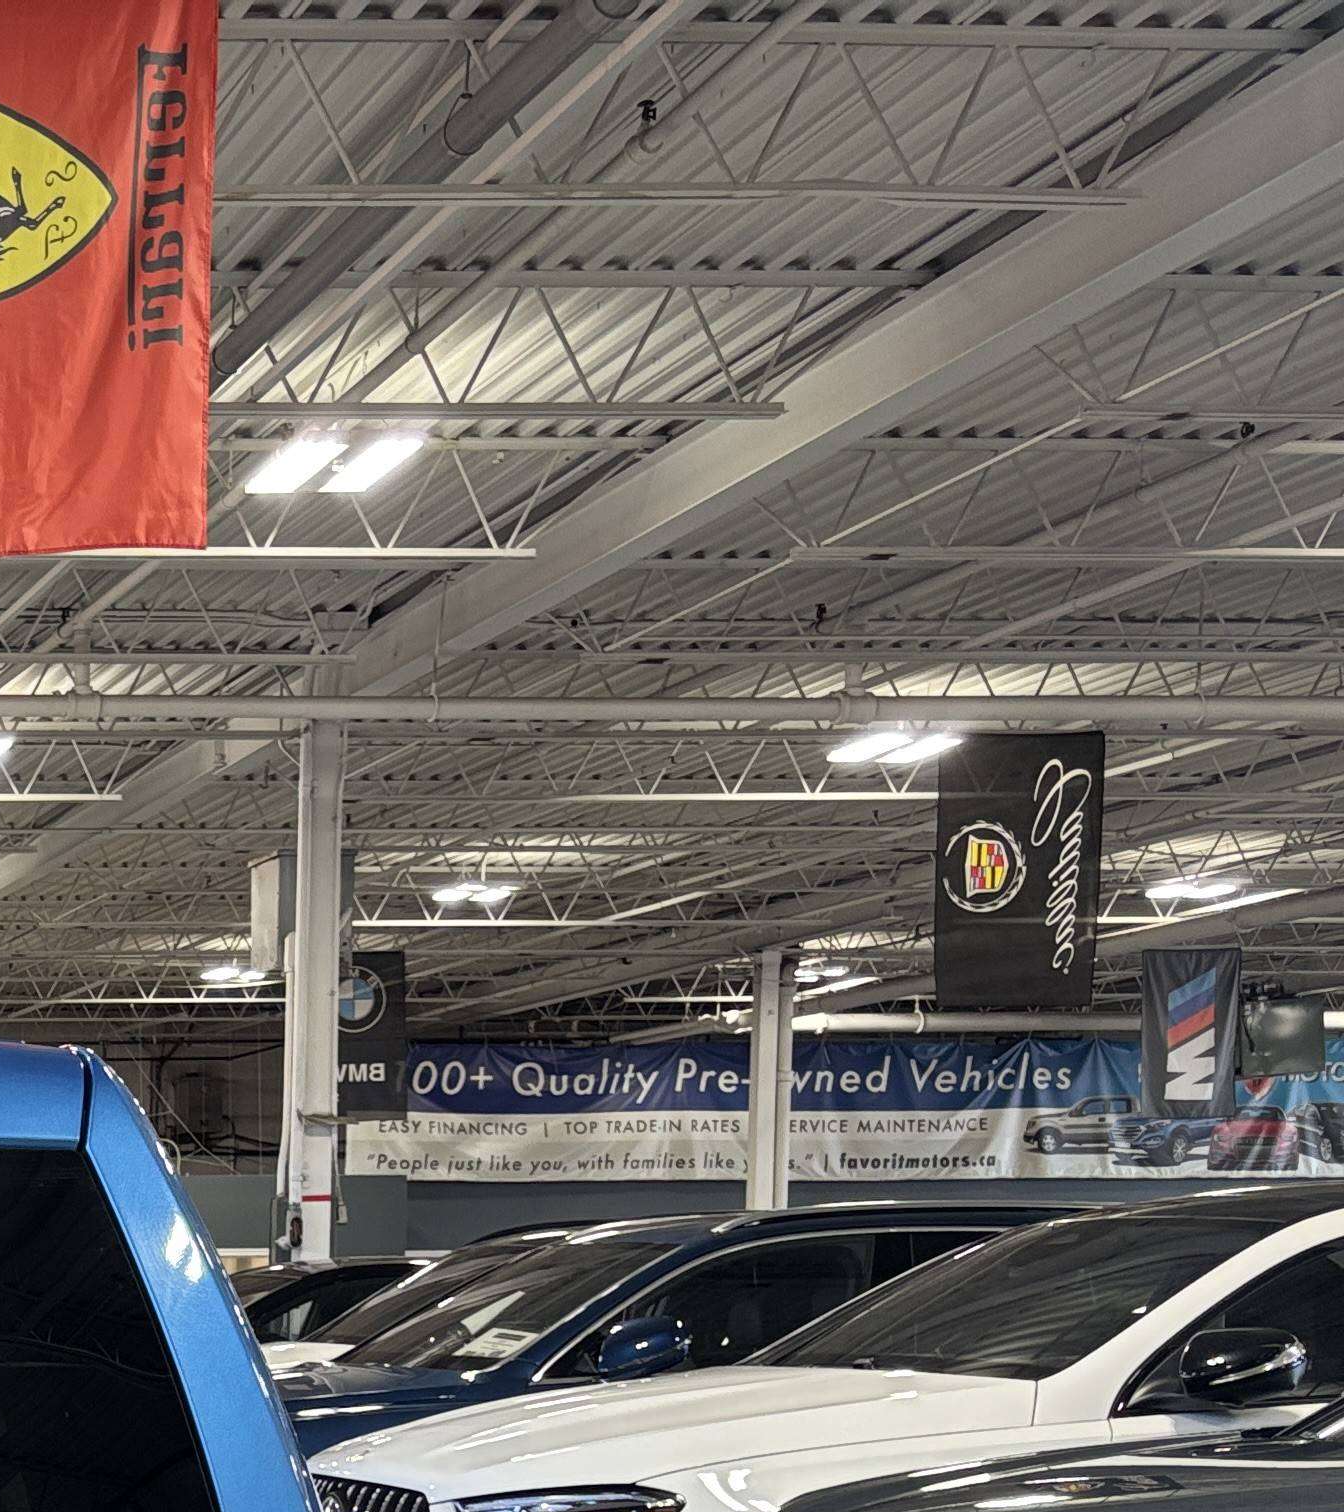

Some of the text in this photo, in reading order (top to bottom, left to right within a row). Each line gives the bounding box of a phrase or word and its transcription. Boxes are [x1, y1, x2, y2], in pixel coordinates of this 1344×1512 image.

[512, 1057, 661, 1104] Quality
[673, 1056, 891, 1094] Pre-wned
[910, 1052, 1073, 1093] Vehicles
[378, 1117, 989, 1137] EASY FINANCING TOP TRADE-IN RATES ERVICE MAINTENANCE
[447, 1153, 482, 1174] just
[488, 1152, 523, 1172] like
[529, 1159, 568, 1175] you,
[577, 1152, 614, 1171] with
[621, 1150, 696, 1171] families
[703, 1151, 736, 1170] like
[839, 1151, 997, 1171] favoritmotors.ca
